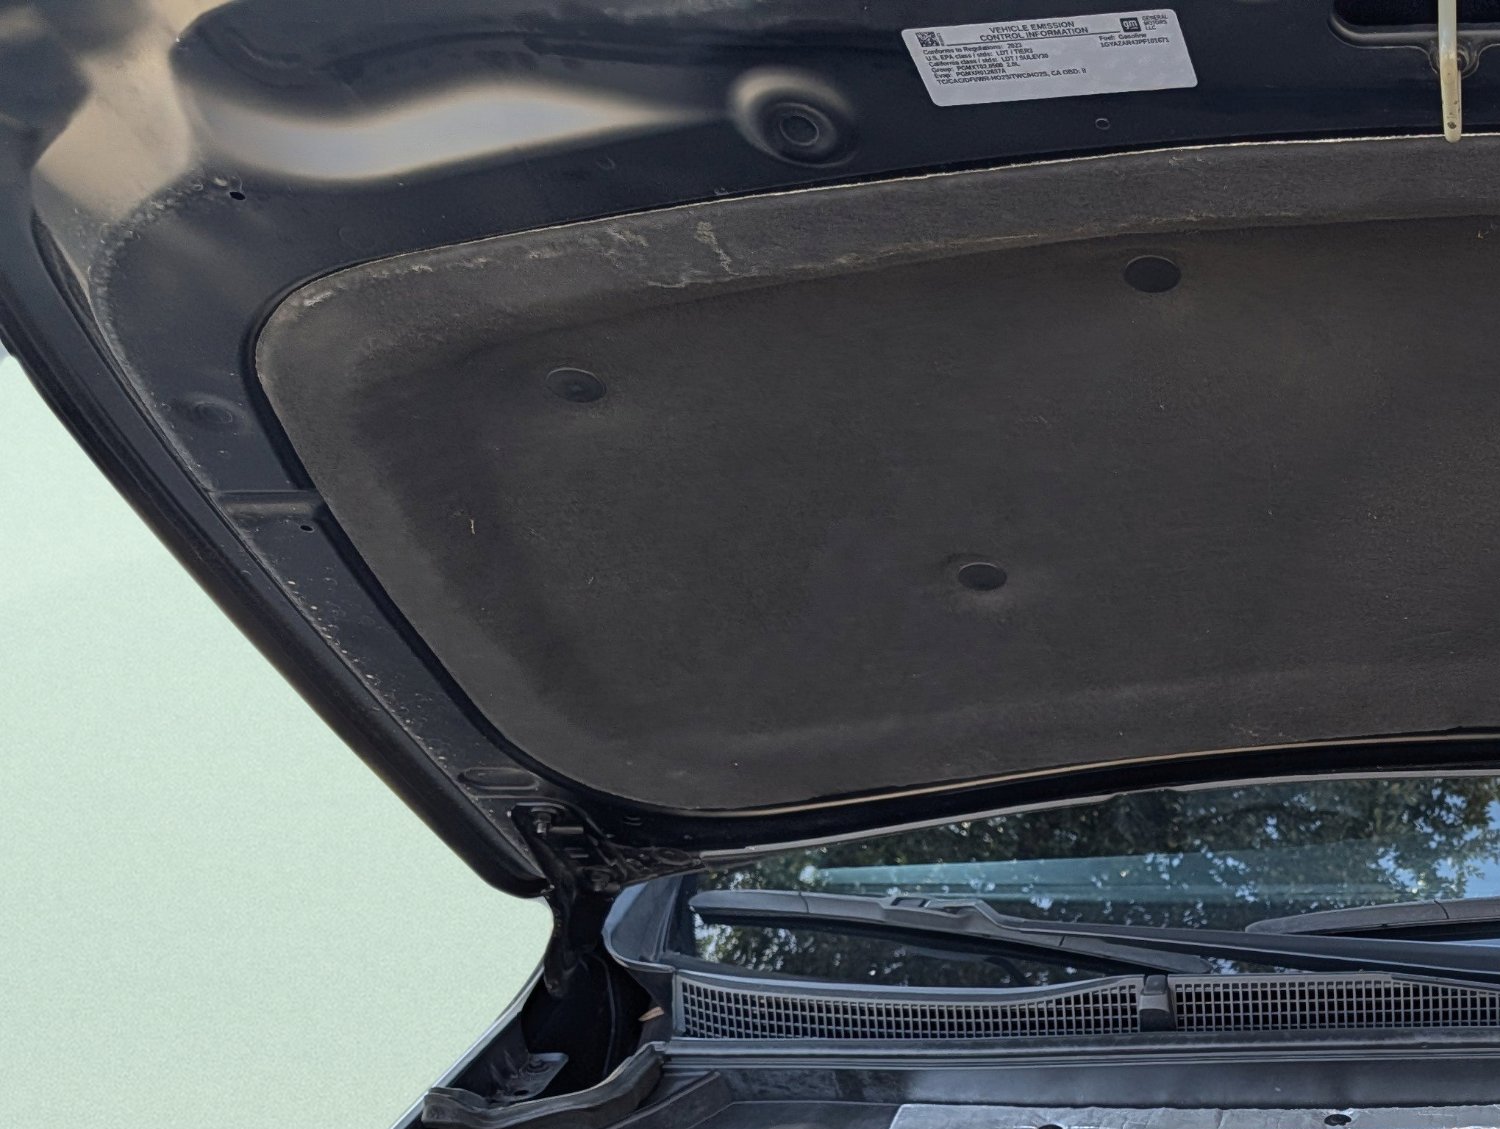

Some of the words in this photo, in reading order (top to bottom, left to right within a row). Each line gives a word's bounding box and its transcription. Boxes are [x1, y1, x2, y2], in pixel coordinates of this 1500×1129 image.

[980, 31, 1024, 42] CONTROL
[1026, 27, 1088, 38] INFORMATION
[989, 24, 1029, 34] VEHICLE
[1031, 21, 1075, 31] EMISSION
